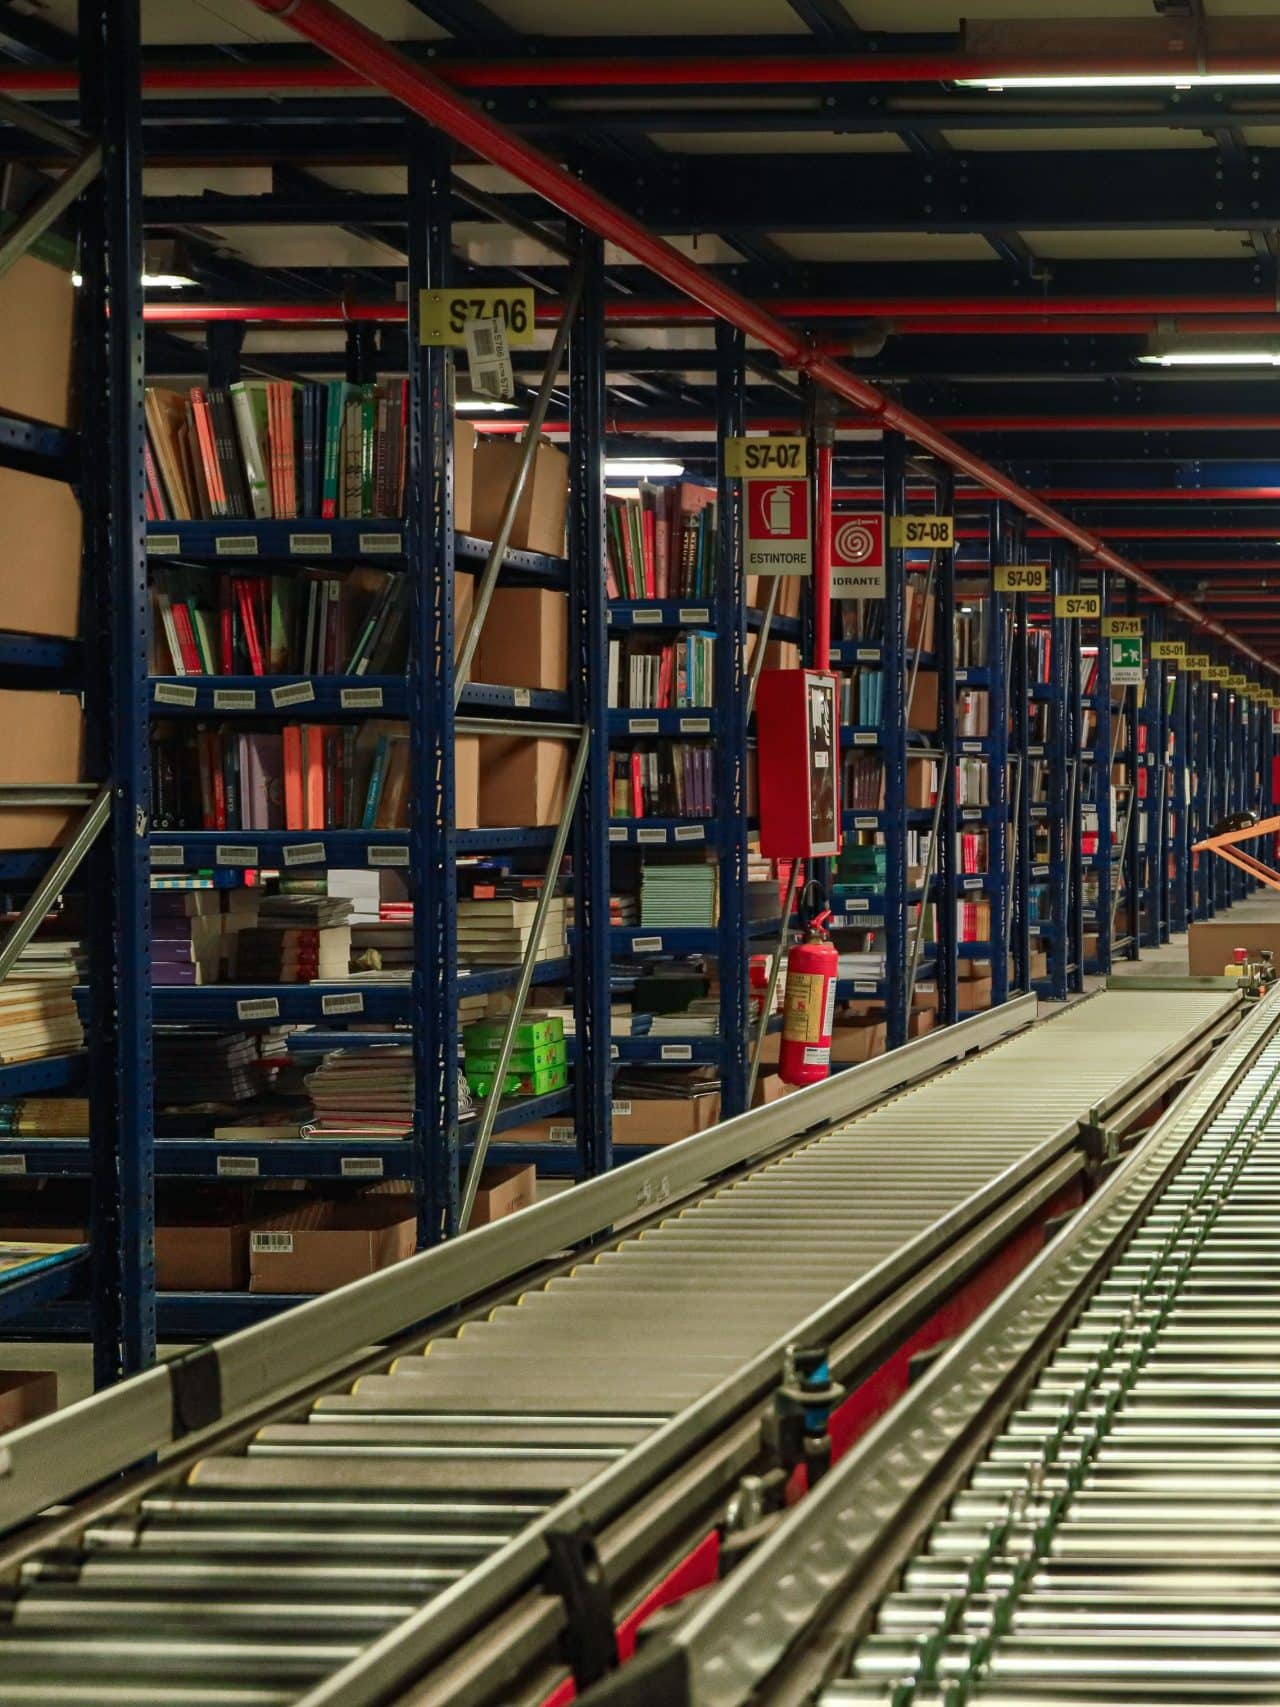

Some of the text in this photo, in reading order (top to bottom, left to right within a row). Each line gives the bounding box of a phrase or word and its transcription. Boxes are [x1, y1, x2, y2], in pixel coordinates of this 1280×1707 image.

[449, 298, 527, 334] S7-06
[745, 443, 800, 469] S7-07
[906, 523, 949, 541] S7-08
[750, 552, 807, 564] ESTINTORE
[833, 577, 881, 586] IDRANTE
[1007, 571, 1042, 586] S7-09
[1066, 599, 1097, 613] S7-10
[1111, 621, 1139, 633] S7-11
[1159, 646, 1184, 656] S5-01
